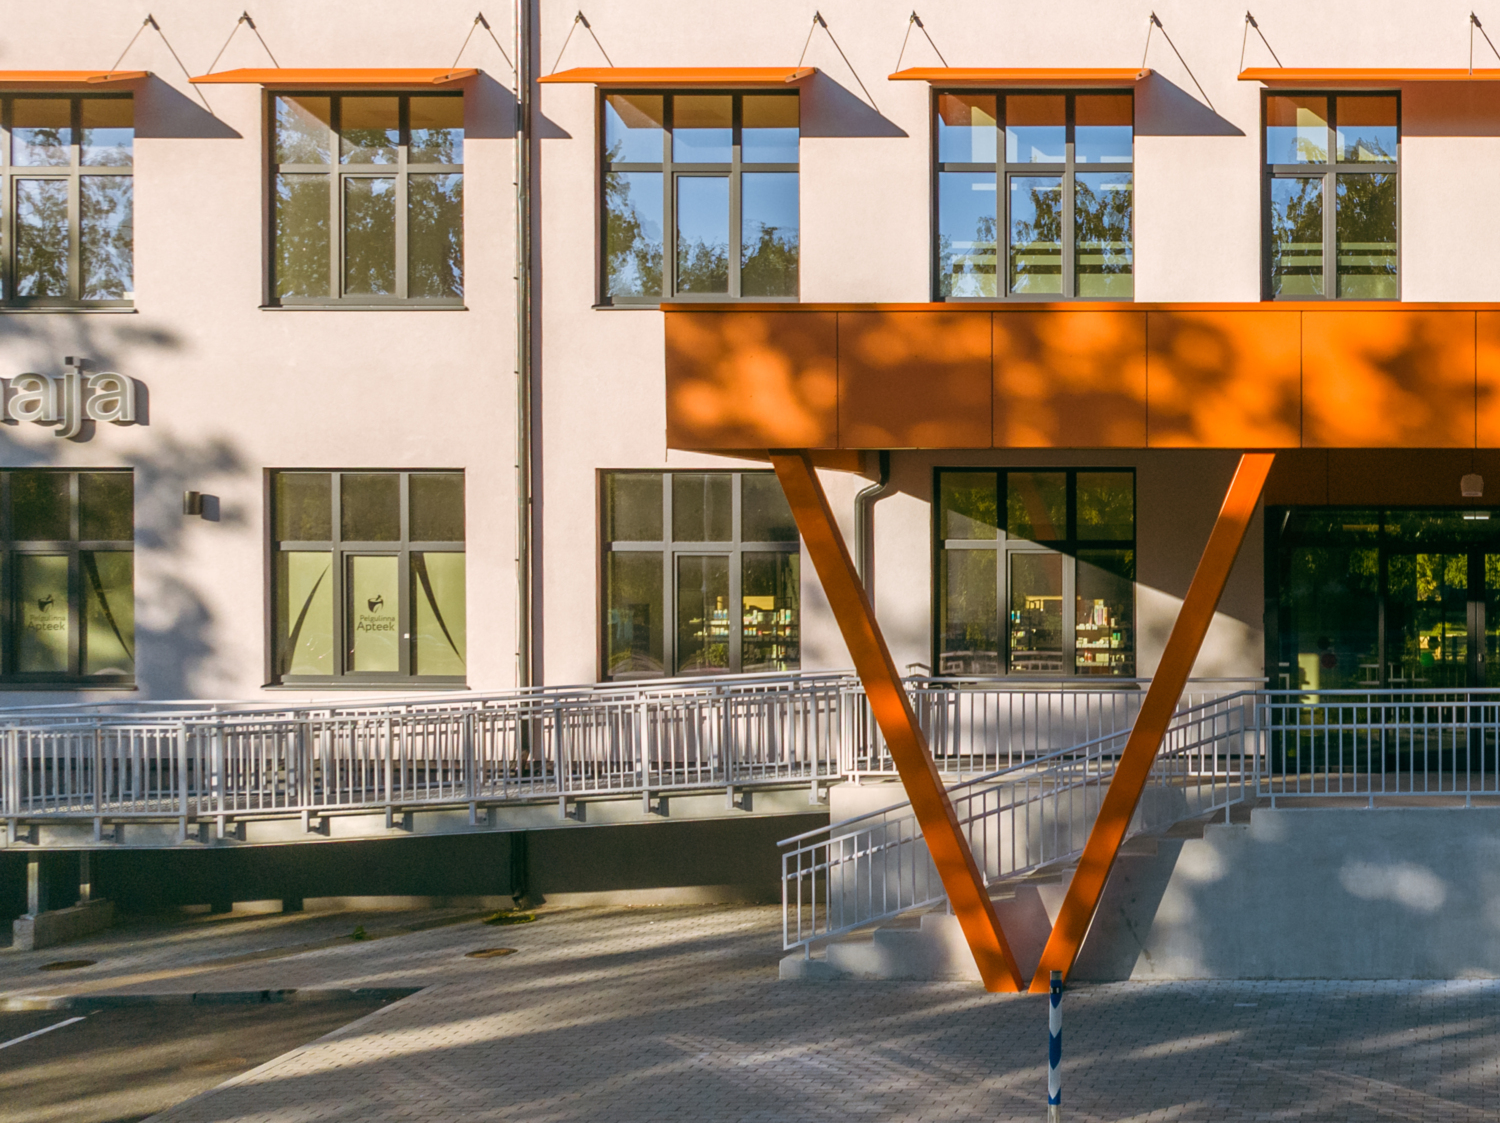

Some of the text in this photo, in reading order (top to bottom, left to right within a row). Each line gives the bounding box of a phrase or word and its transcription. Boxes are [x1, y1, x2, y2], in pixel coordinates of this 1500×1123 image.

[0, 356, 135, 438] aja
[360, 614, 396, 623] Pelgulinna
[356, 621, 396, 633] Apteek
